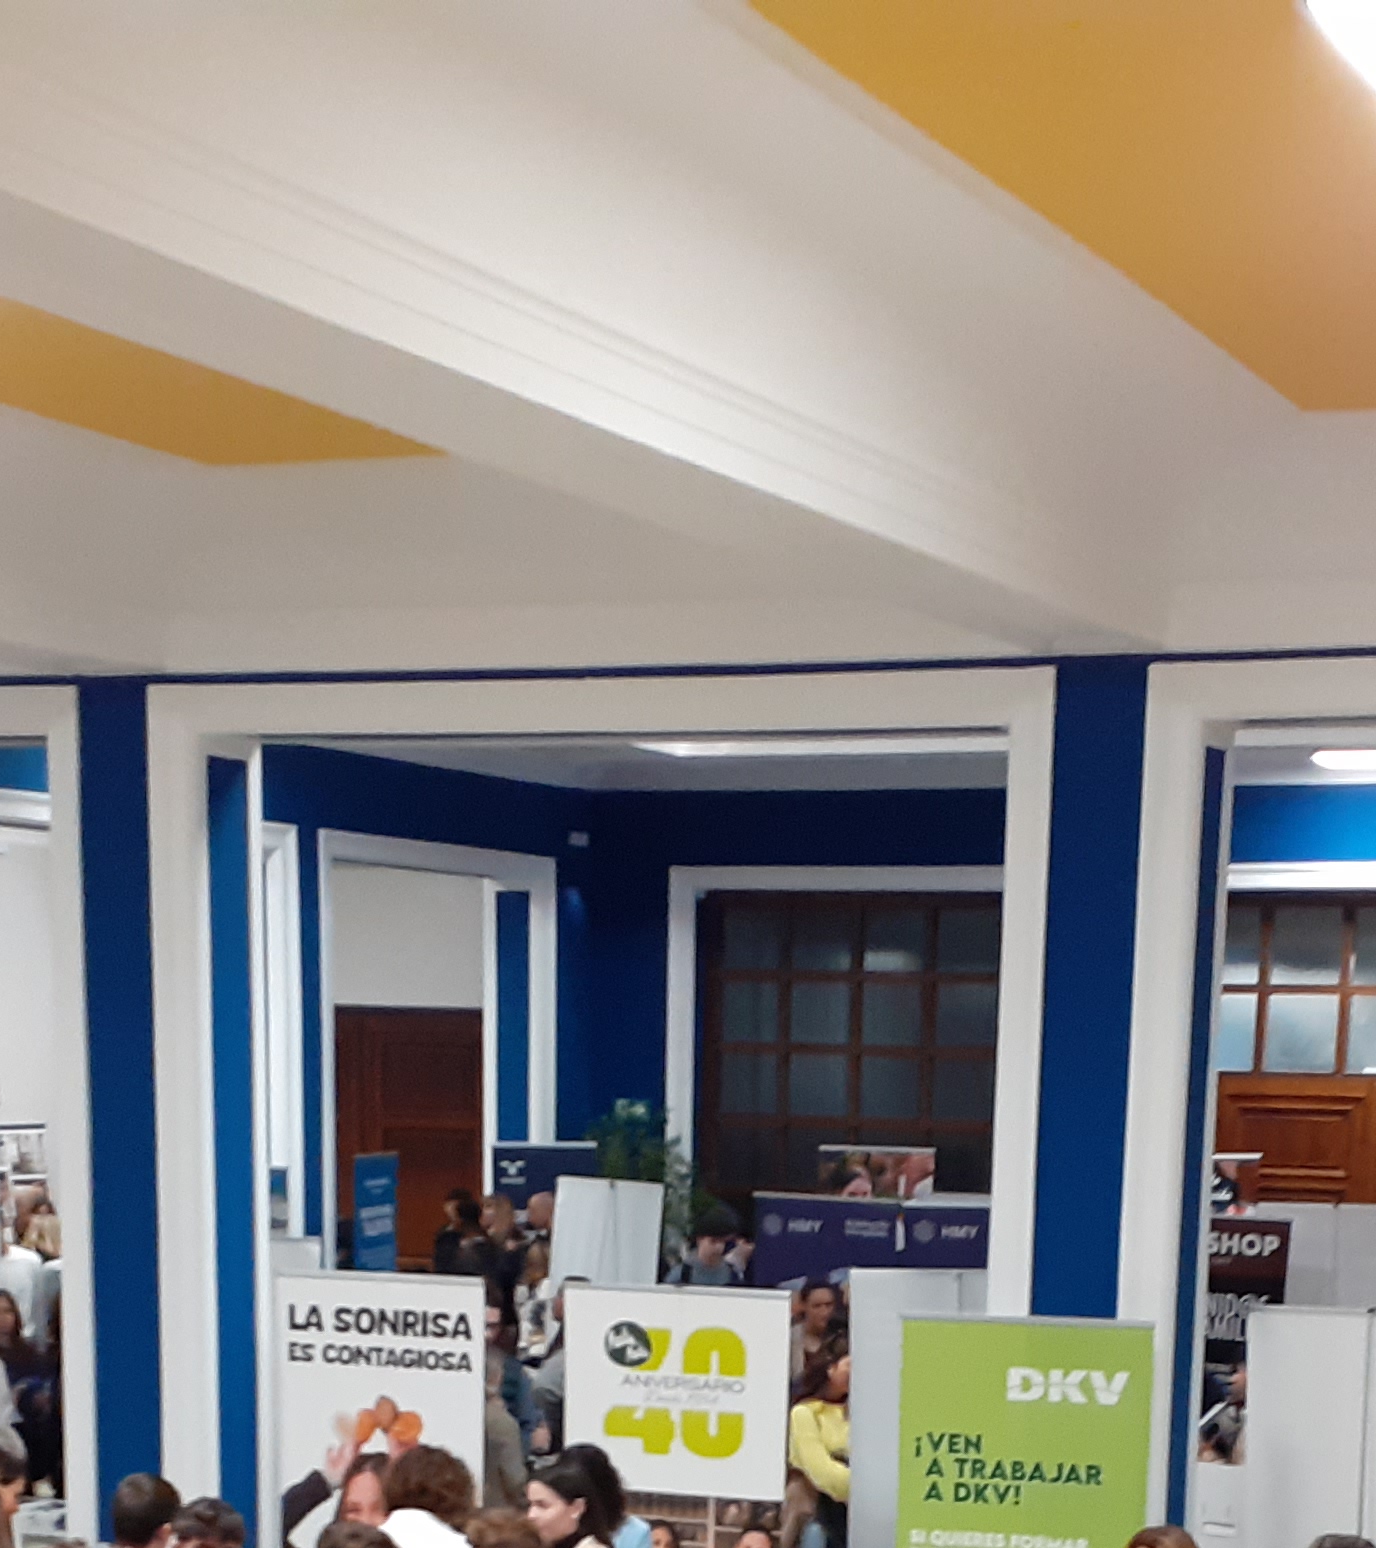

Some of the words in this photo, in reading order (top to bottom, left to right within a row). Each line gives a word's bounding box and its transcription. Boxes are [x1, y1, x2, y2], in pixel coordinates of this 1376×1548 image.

[288, 1303, 323, 1332] LA
[333, 1306, 472, 1341] SONRISA
[288, 1341, 315, 1362] ES
[323, 1343, 473, 1372] CONTAGIOSA
[1006, 1365, 1131, 1406] DKV
[915, 1431, 983, 1458] ¡VEN
[925, 1457, 944, 1478] A
[954, 1457, 1103, 1487] TRABAJAR
[924, 1480, 944, 1502] A
[953, 1481, 1023, 1506] DKV!
[930, 1530, 1006, 1548] QUIERES
